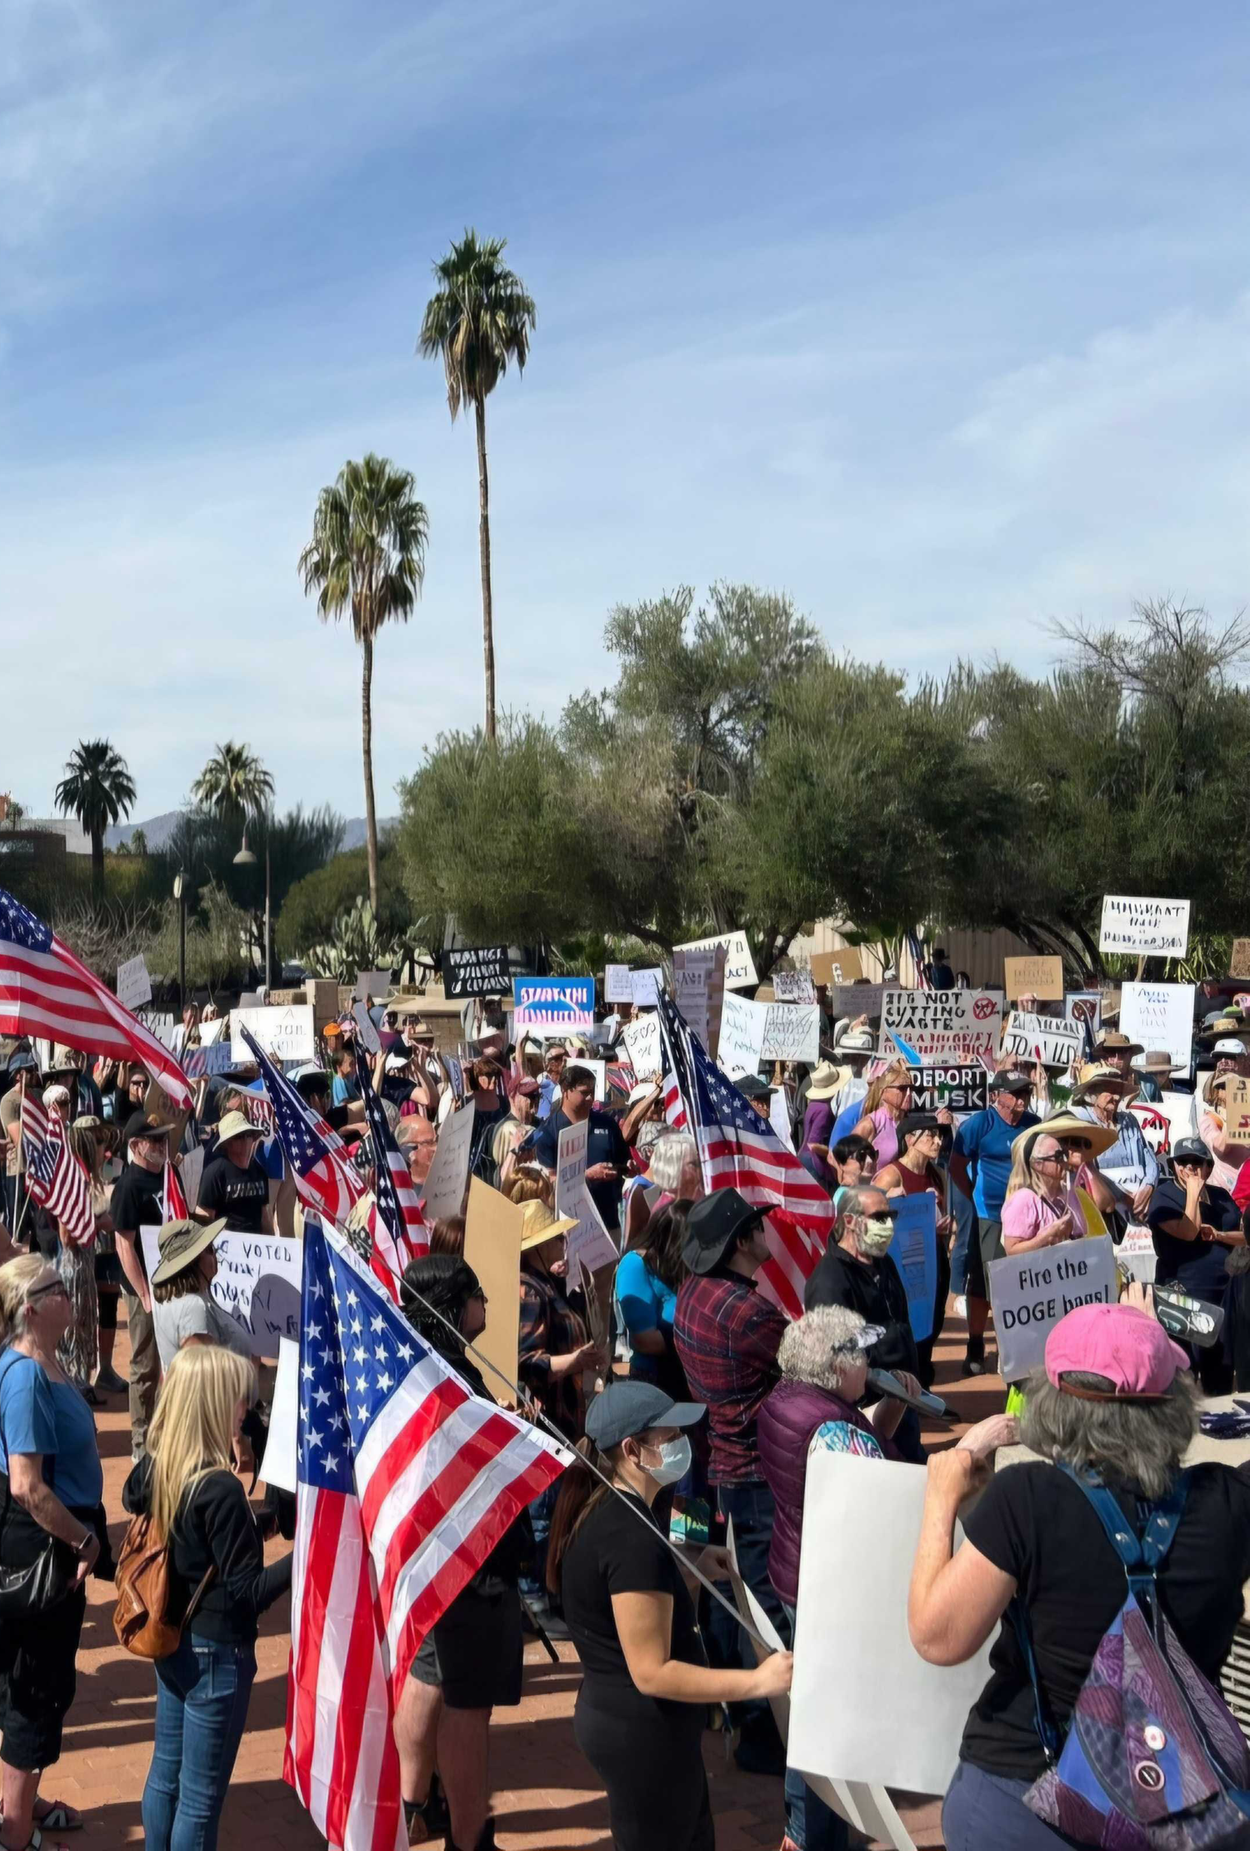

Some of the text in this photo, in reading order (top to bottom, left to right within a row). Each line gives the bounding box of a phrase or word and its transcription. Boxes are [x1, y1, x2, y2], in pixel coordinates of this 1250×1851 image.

[909, 1068, 986, 1087] DEPORT
[911, 1088, 984, 1109] MUSK
[1019, 1258, 1088, 1290] Fire the
[1002, 1298, 1056, 1330] DOGE
